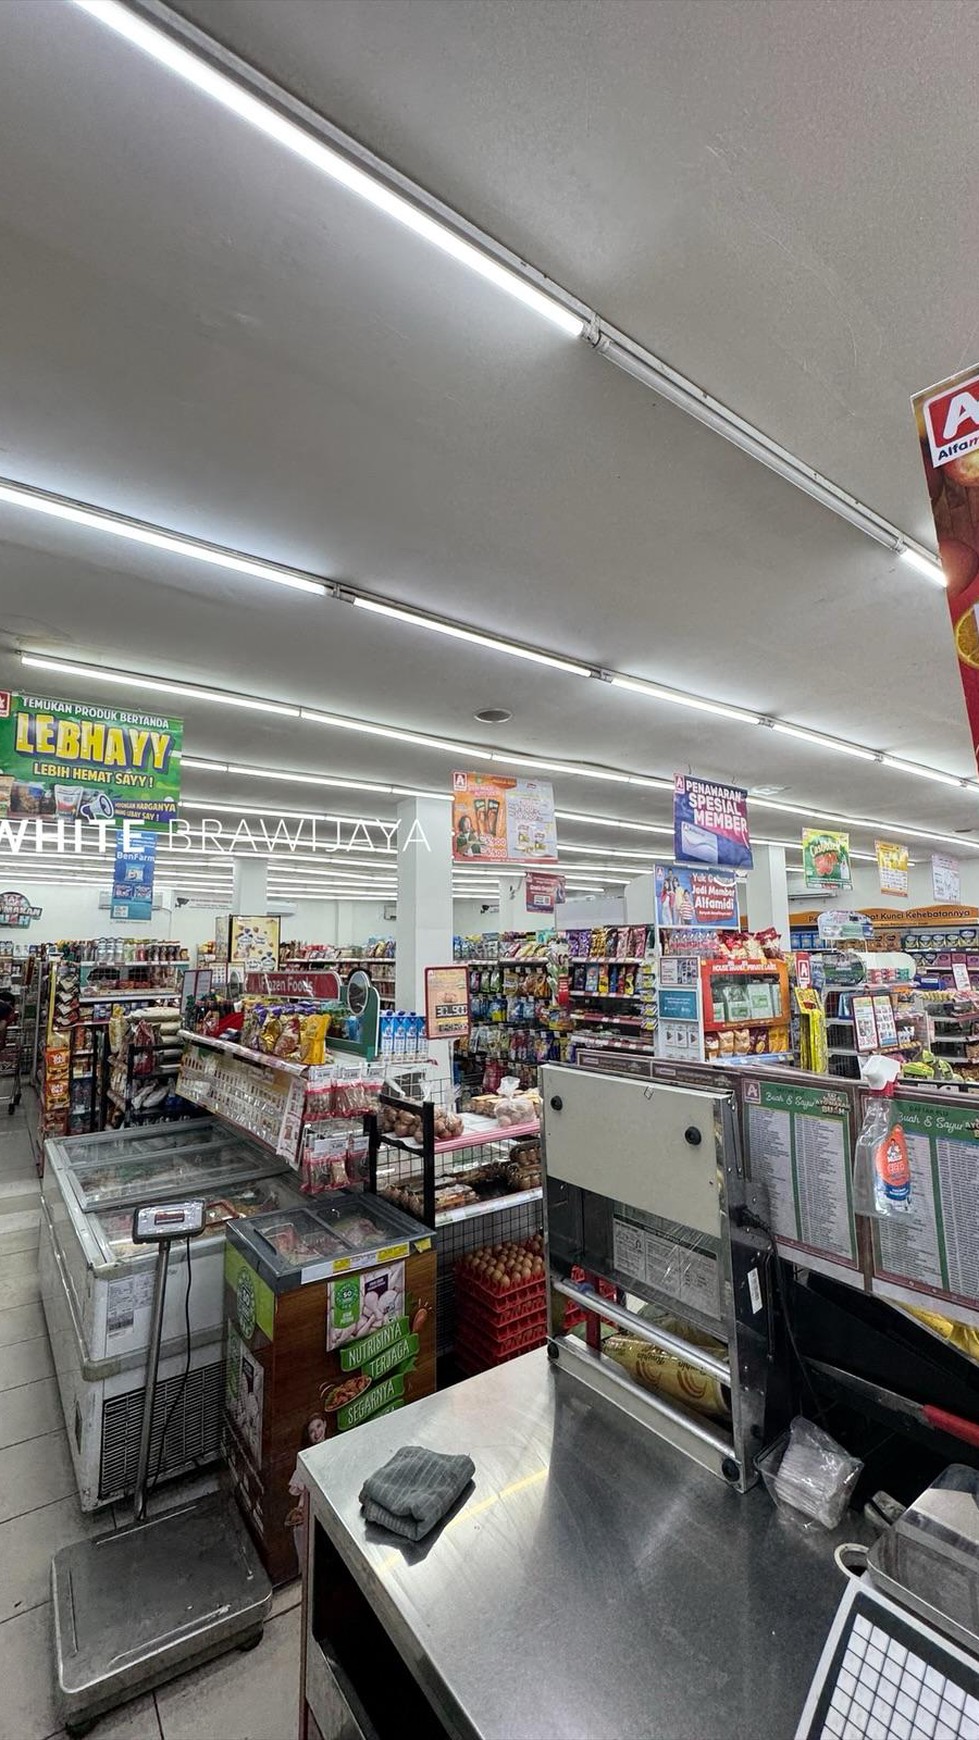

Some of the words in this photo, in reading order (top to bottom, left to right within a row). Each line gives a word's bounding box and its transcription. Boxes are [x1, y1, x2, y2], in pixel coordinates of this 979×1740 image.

[22, 698, 73, 714] TEMUKAN
[75, 705, 118, 721] PRODUK
[119, 712, 170, 729] BERTANDA
[15, 711, 171, 770] LEBHAYY
[34, 763, 70, 779] LEBIH
[73, 768, 113, 785] HEMAT
[115, 774, 147, 787] SAYY
[685, 780, 742, 802] PENAWARAN
[689, 793, 742, 816] SPESIAL
[694, 811, 748, 833] MEMBER
[117, 852, 155, 862] BenFarm
[692, 885, 707, 894] Jadi
[708, 886, 735, 896] Member
[695, 896, 734, 910] Alfamidi
[881, 912, 904, 920] Kunci
[906, 908, 970, 920] Kehebatannya
[795, 1096, 815, 1110] Sayur
[936, 1117, 964, 1133] Sayur
[348, 1322, 402, 1366] NUTRISINYA
[369, 1340, 410, 1378] TERJAGA
[347, 1379, 395, 1425] SEGARNYA
